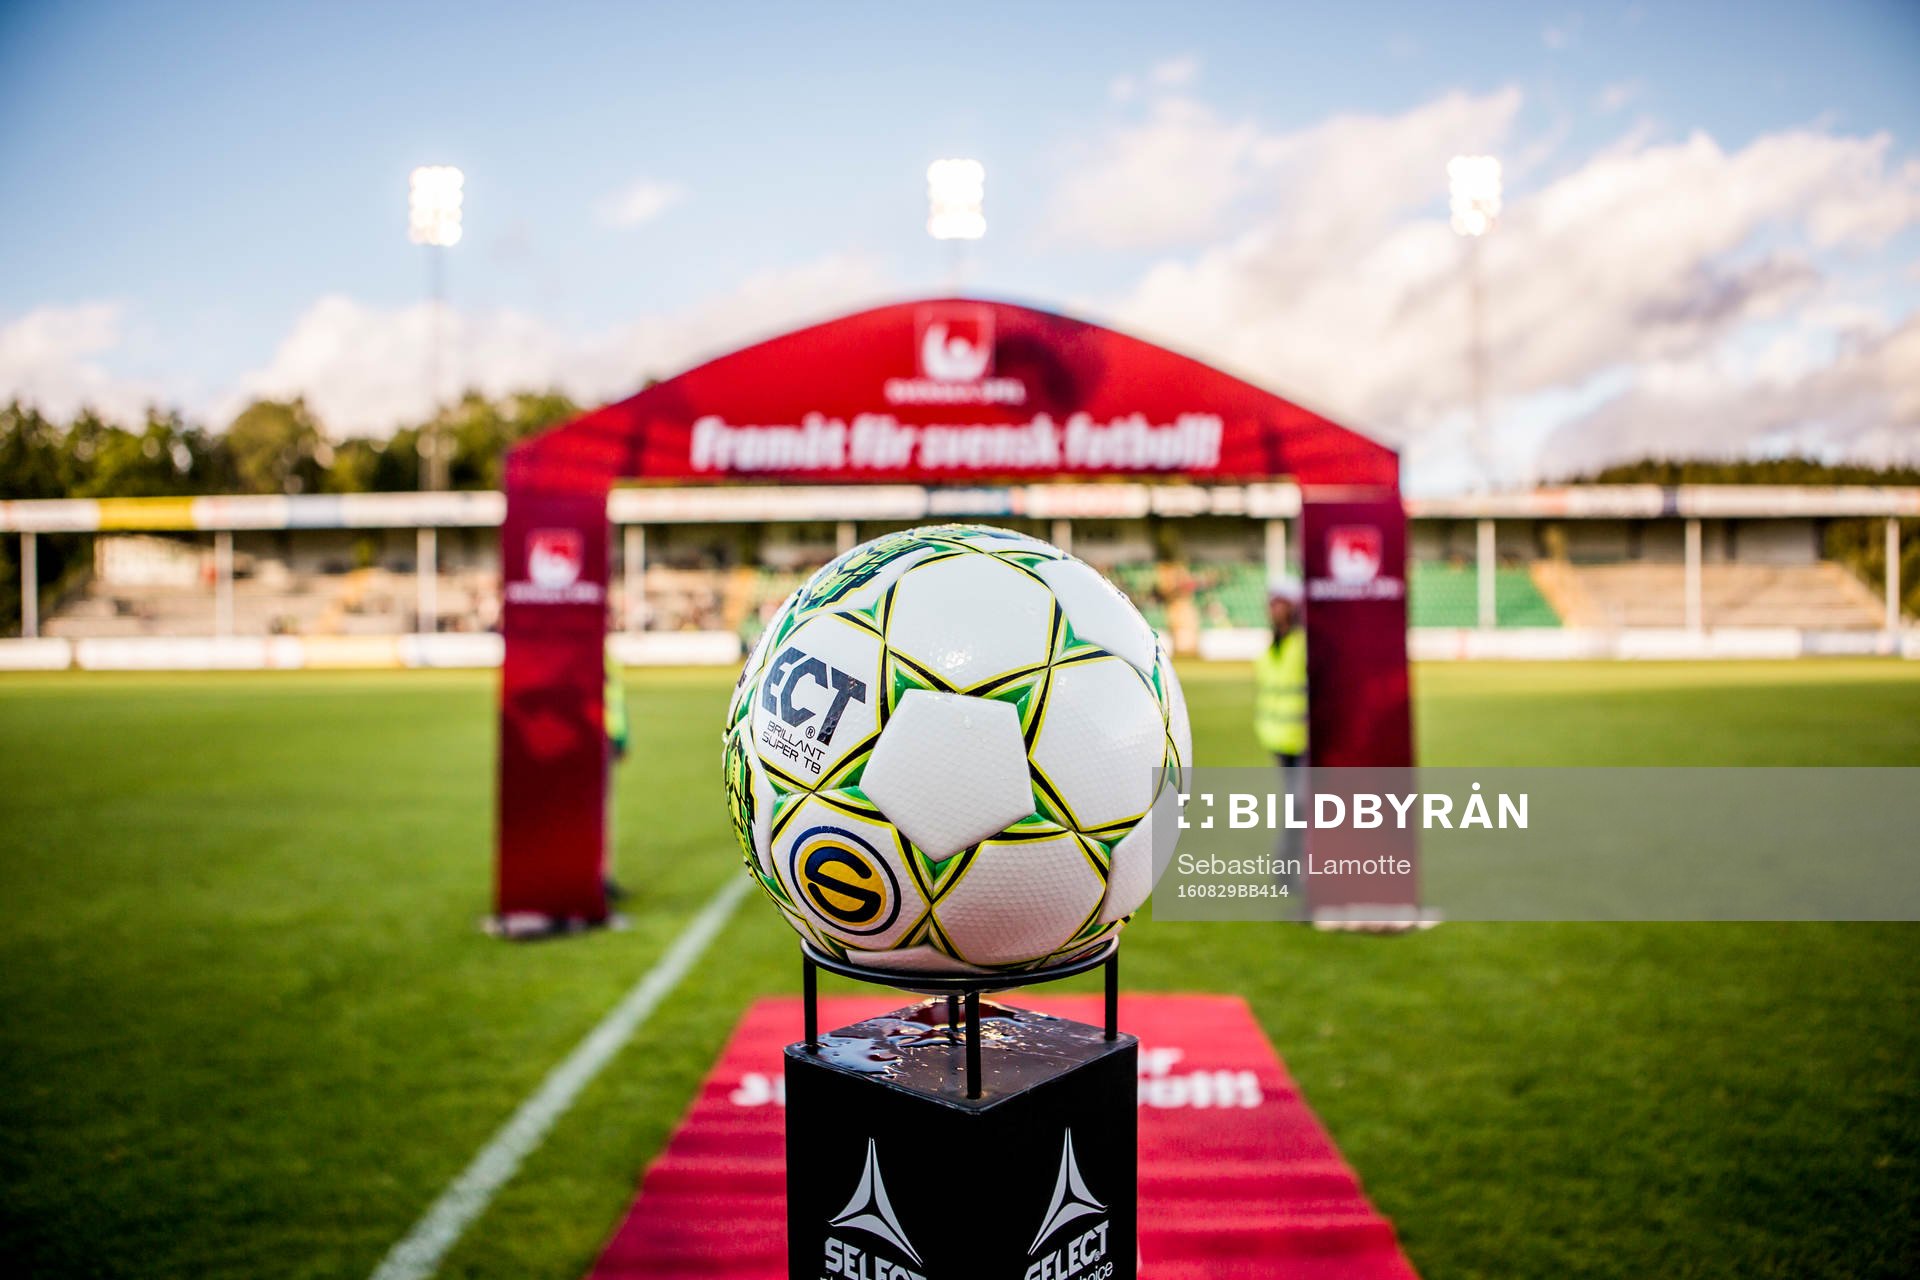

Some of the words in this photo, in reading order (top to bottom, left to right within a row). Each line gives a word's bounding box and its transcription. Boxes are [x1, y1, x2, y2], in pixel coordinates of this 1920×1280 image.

[762, 731, 799, 762] SUPER
[803, 756, 821, 775] TB
[767, 720, 826, 760] BRILLANT
[825, 1236, 927, 1280] SELE
